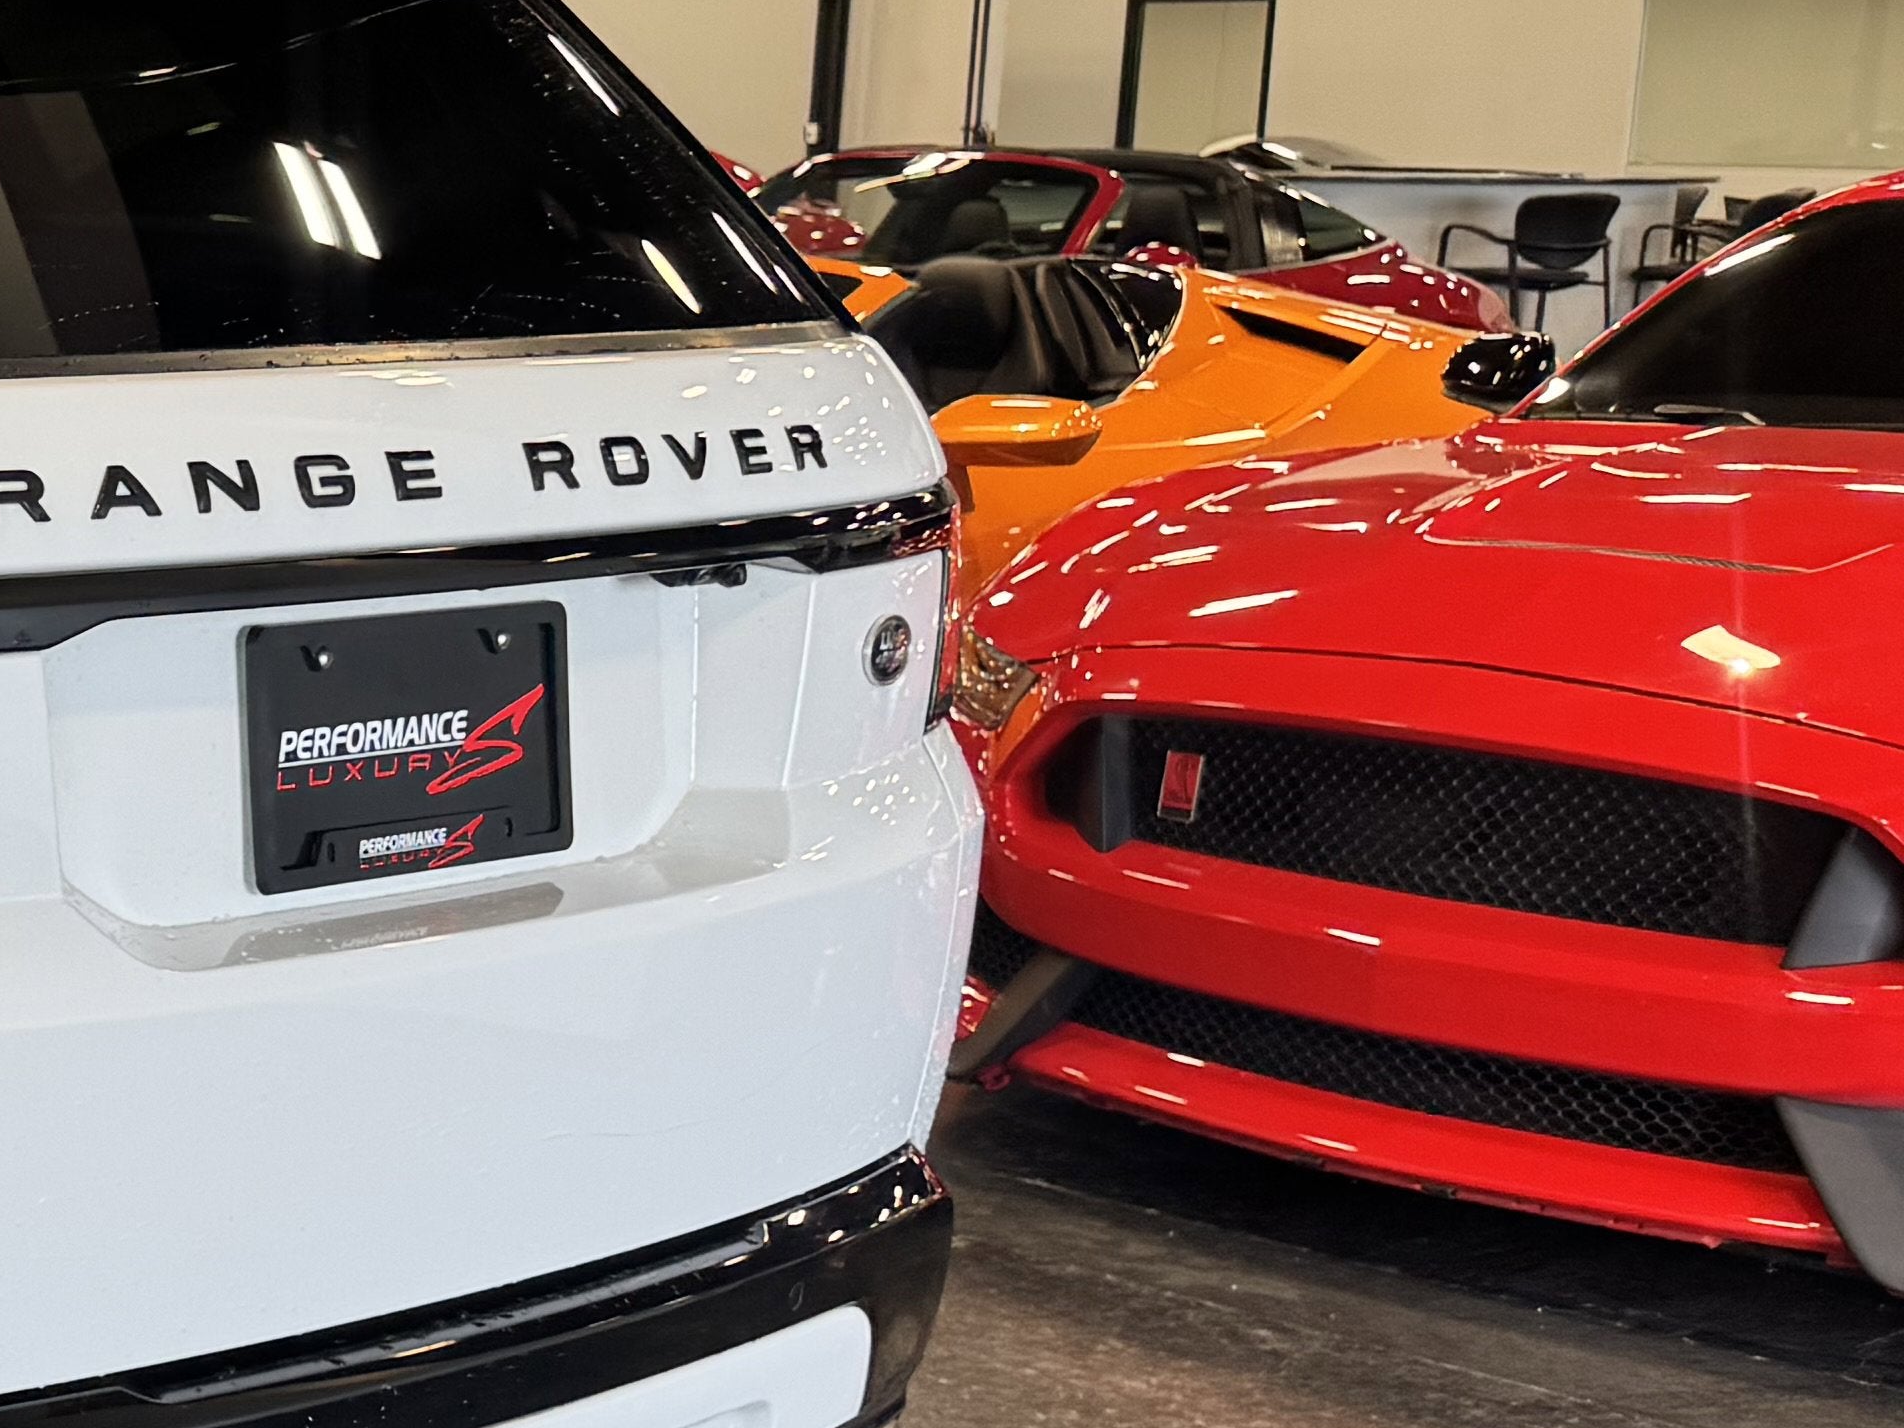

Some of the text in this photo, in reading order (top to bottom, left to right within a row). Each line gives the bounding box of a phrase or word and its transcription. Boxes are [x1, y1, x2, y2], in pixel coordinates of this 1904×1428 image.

[521, 424, 828, 492] ROVER
[278, 709, 469, 763] PERFORMANCE
[277, 749, 461, 791] LUXURY
[359, 827, 448, 855] PERFORMANCE
